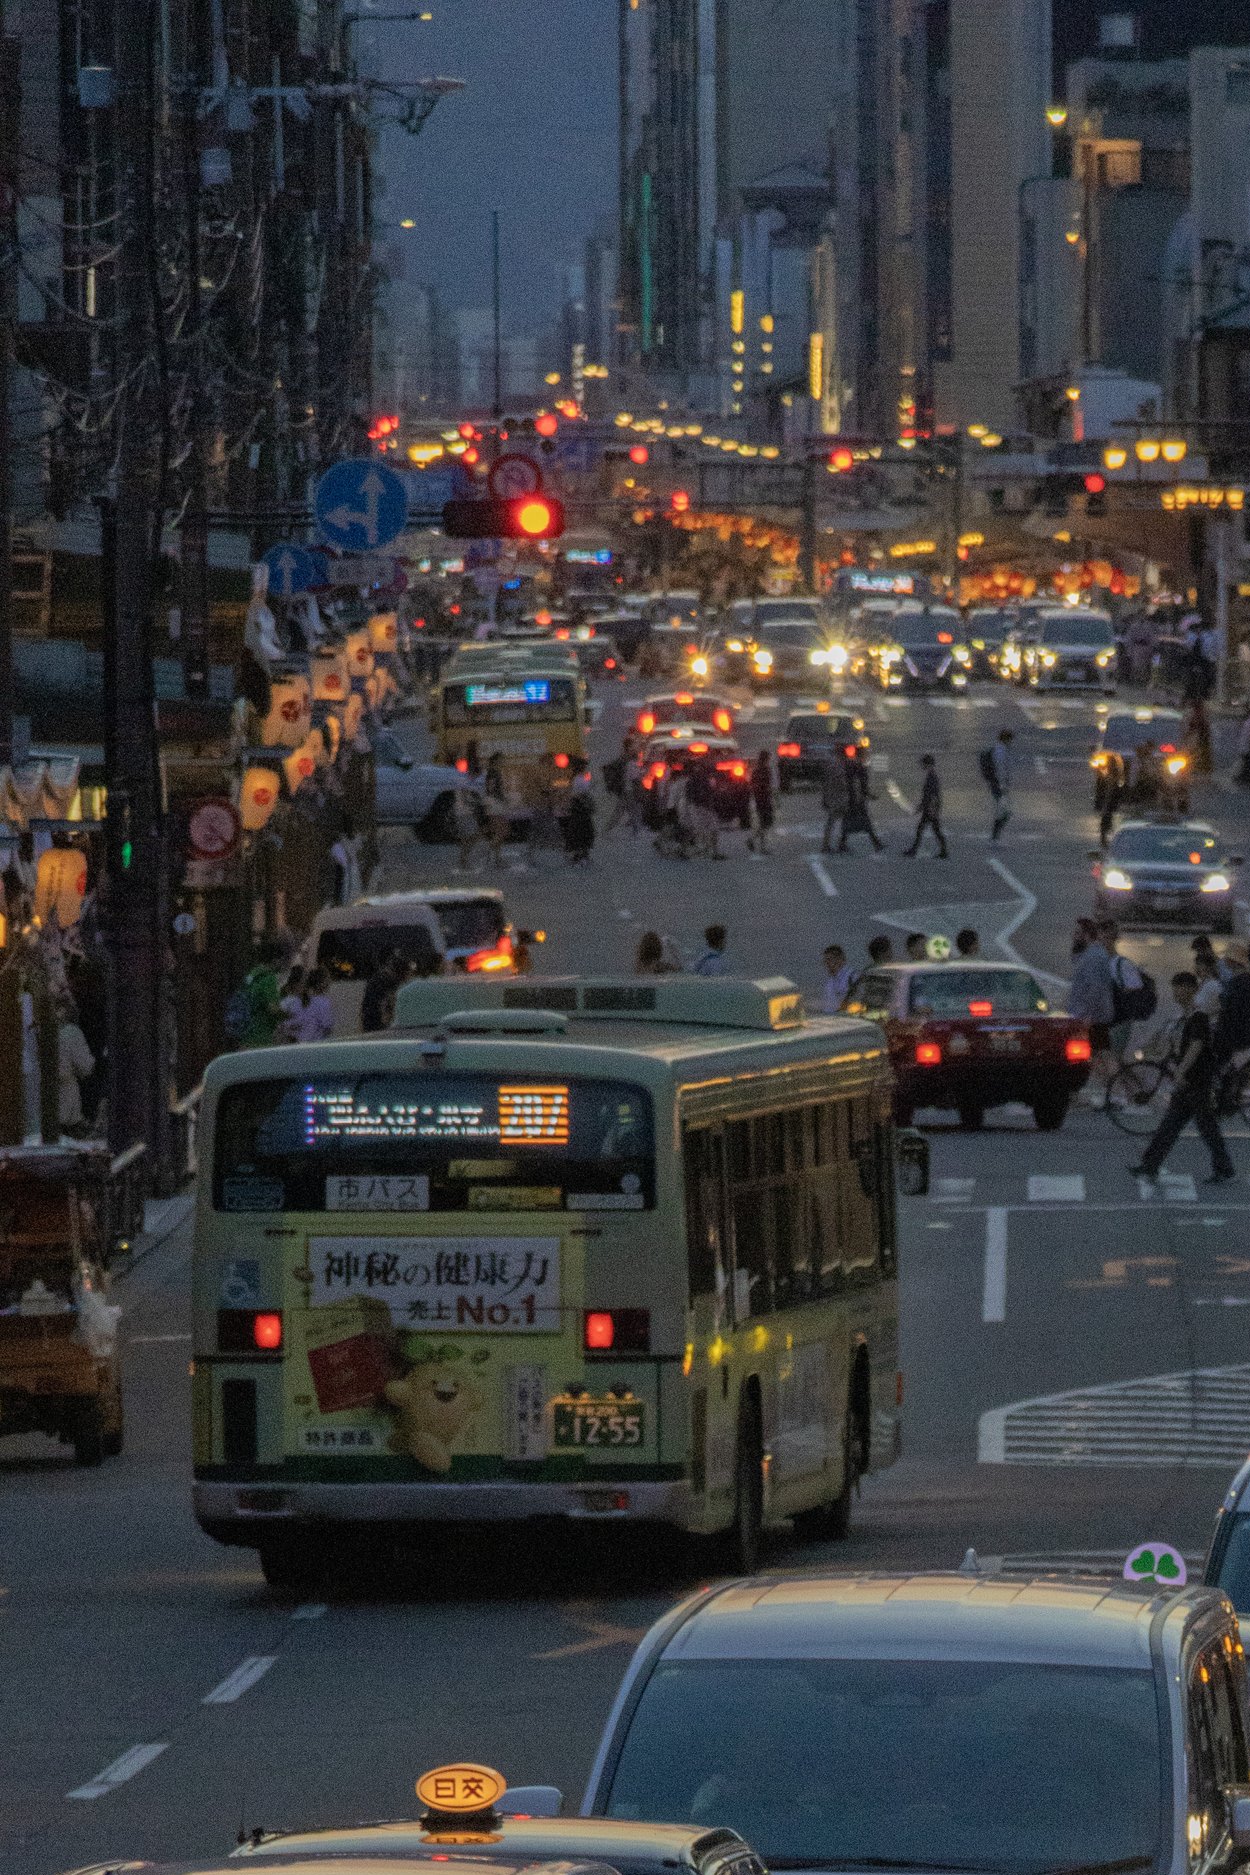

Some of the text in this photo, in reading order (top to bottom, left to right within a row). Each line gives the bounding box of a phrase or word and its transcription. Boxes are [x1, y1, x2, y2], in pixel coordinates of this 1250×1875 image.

[338, 1179, 419, 1199] 市バス
[324, 1250, 549, 1297] 神秘の健康力
[434, 1776, 484, 1800] 日交
